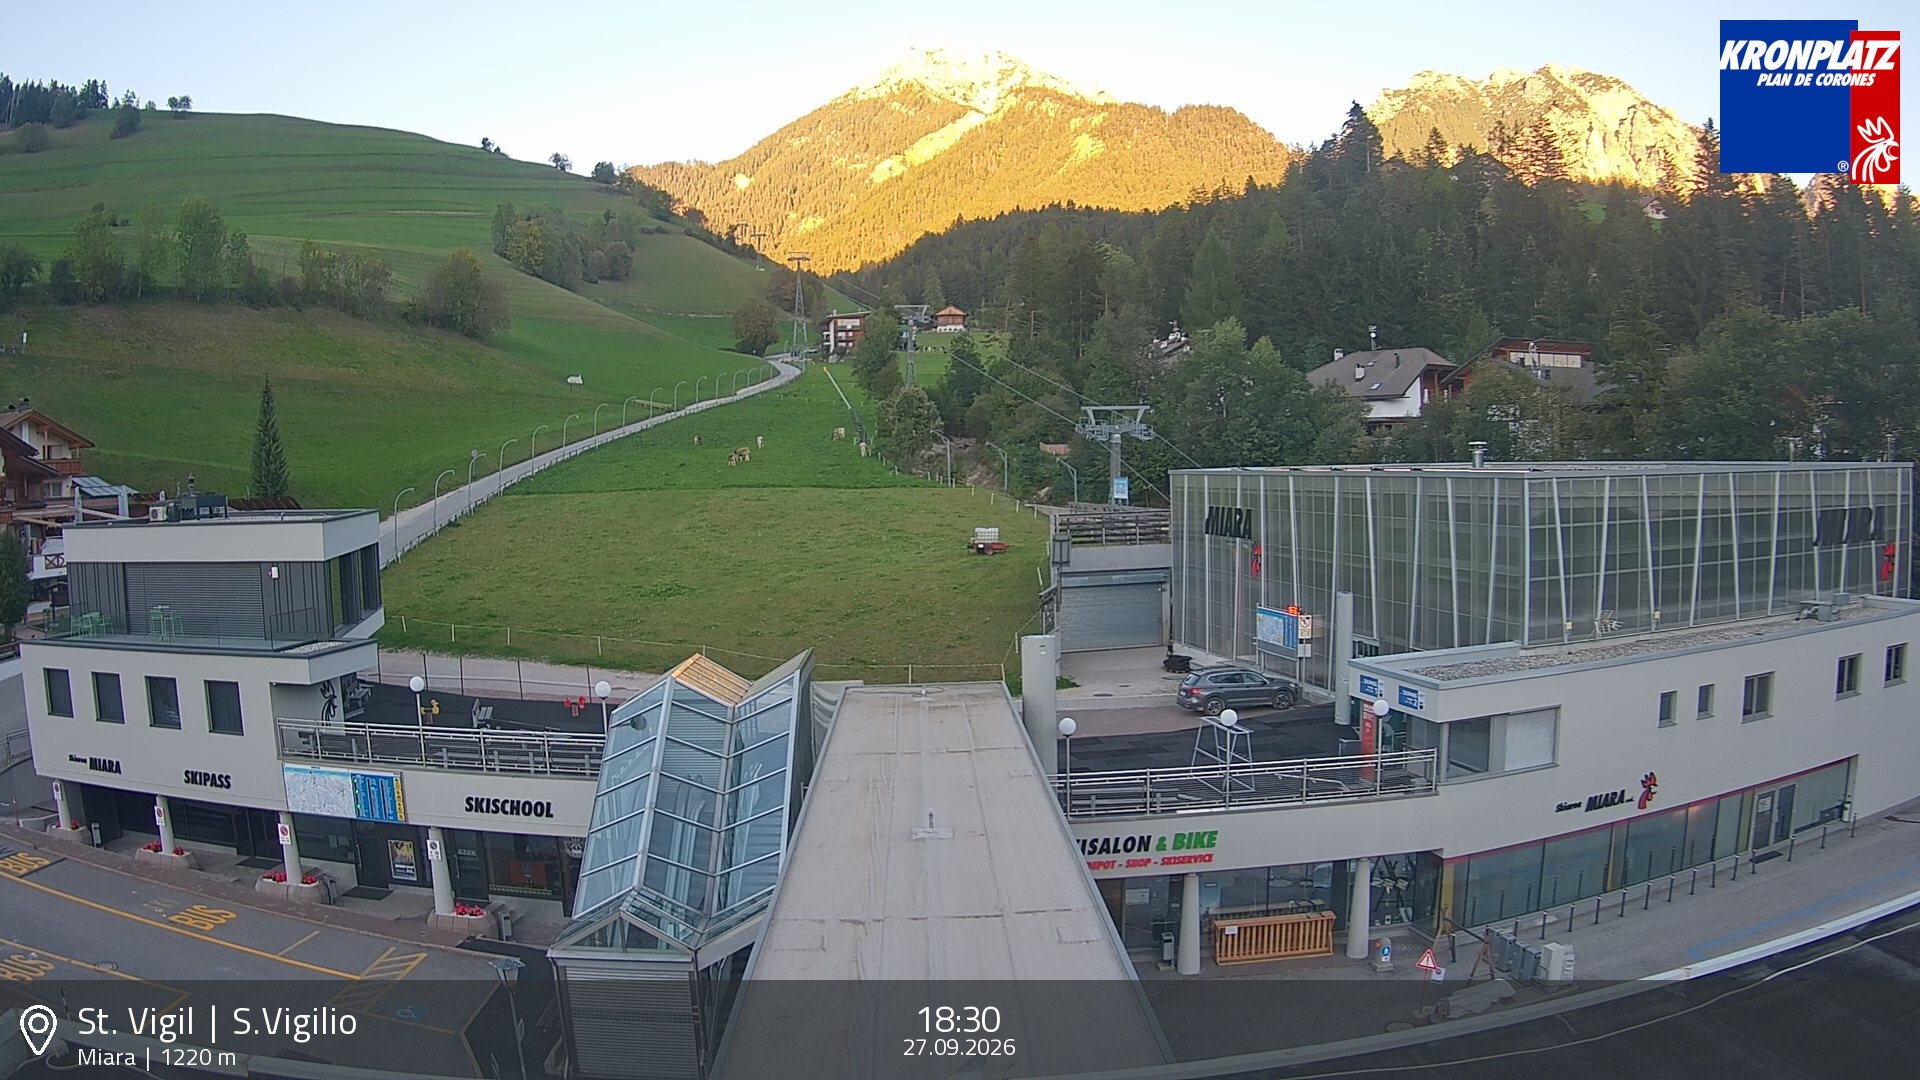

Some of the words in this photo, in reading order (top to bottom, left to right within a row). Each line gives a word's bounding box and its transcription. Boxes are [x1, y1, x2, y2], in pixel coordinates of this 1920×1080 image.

[1205, 506, 1252, 539] MIARA
[89, 757, 122, 774] MIARA
[184, 770, 231, 789] SKIPASS
[465, 796, 554, 818] SKISCHOOL
[1584, 789, 1625, 812] MIARA
[1155, 836, 1168, 852] &
[1172, 831, 1218, 850] BIKE
[0, 852, 51, 875] BUS
[1125, 858, 1152, 868] SHOP
[1160, 853, 1214, 866] SKISERVICE
[168, 904, 237, 931] BUS
